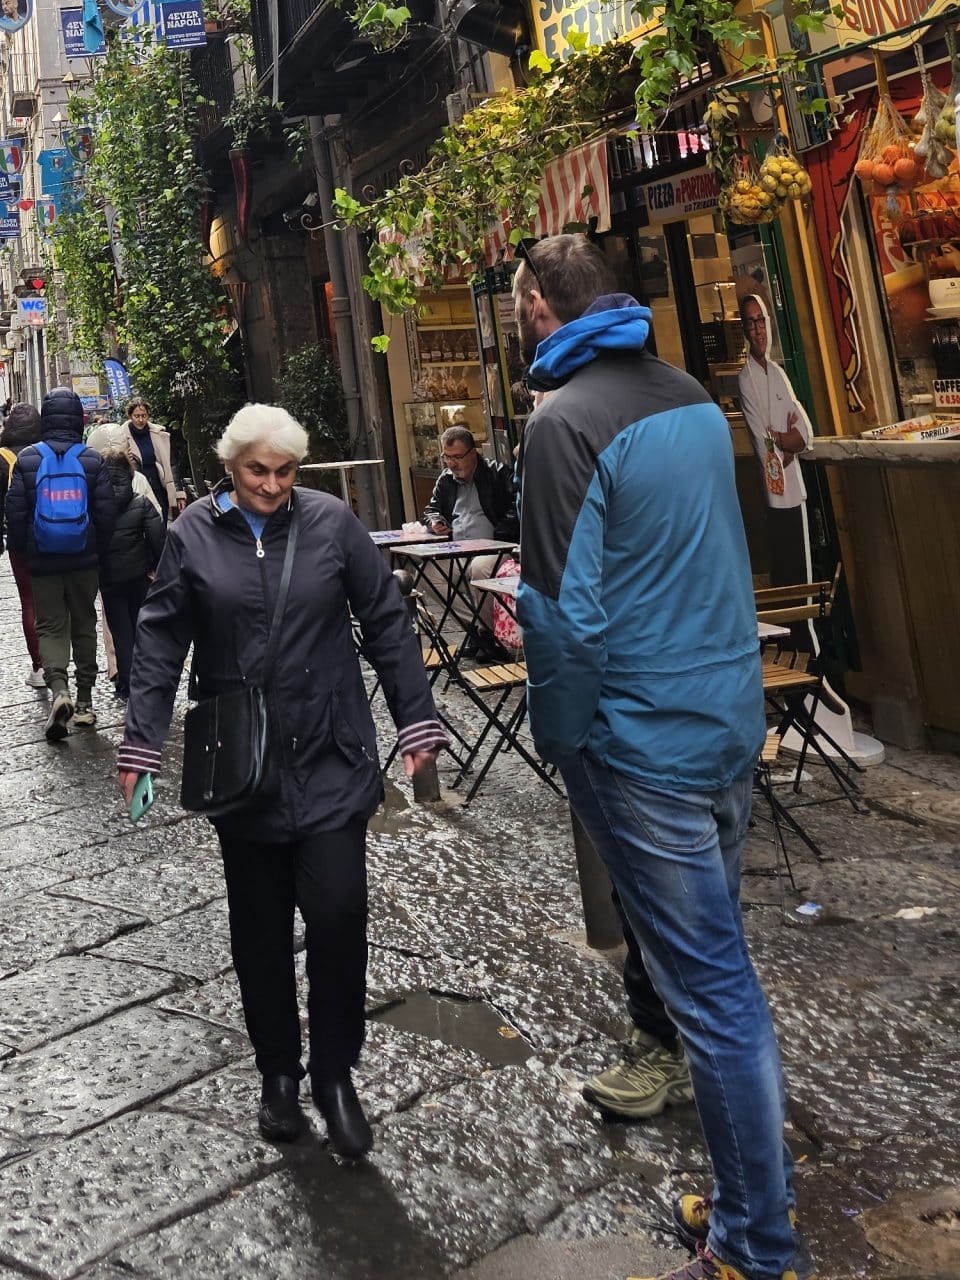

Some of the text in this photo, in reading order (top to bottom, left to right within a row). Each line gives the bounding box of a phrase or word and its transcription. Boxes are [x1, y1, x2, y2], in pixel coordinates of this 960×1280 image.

[168, 11, 198, 21] 4EVER
[167, 18, 201, 28] NAPOLI
[647, 182, 675, 210] PIZZA
[920, 424, 950, 441] SORBILLO
